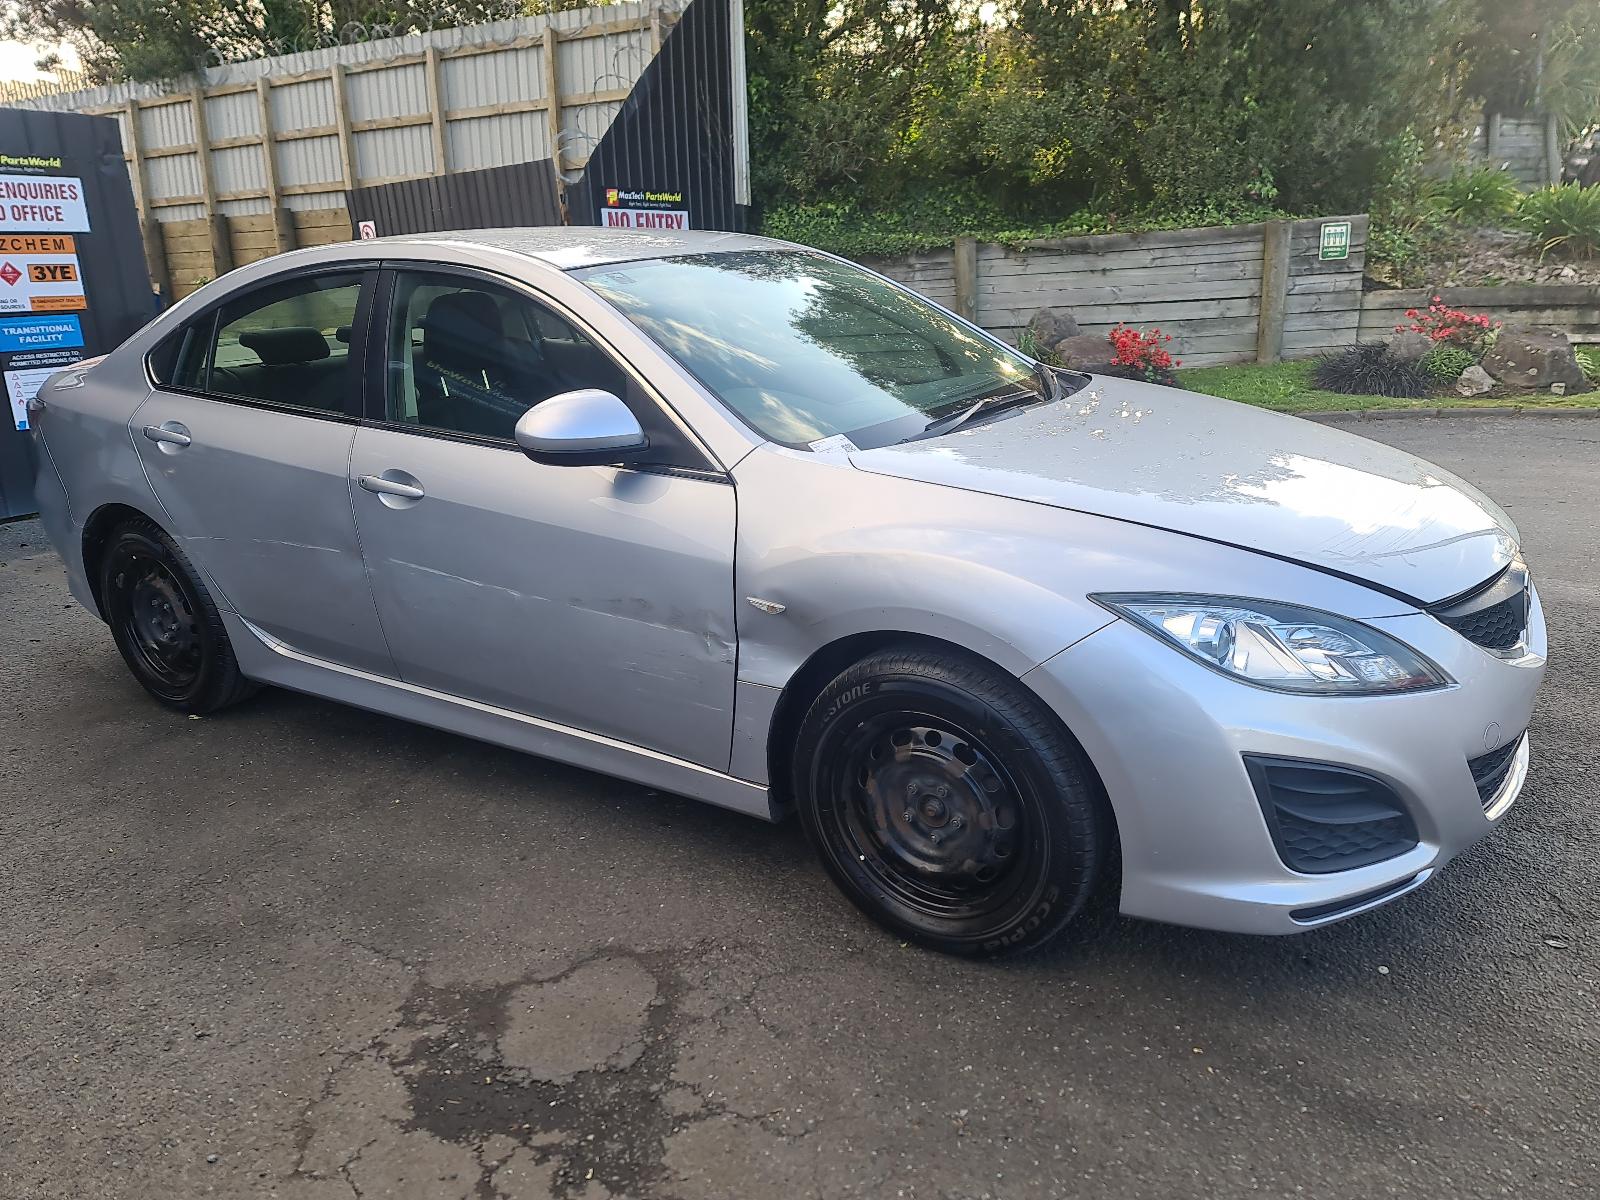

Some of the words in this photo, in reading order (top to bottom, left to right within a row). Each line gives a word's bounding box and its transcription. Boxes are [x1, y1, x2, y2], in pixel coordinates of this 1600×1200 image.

[0, 155, 61, 168] PartsWorld
[0, 182, 78, 201] ENQUIRIES
[645, 191, 682, 202] PartsWorld
[11, 204, 64, 221] OFFICE
[607, 211, 631, 227] NO
[635, 212, 683, 229] ENTRY
[33, 265, 73, 280] 3YE
[2, 324, 75, 335] TRANSITIONAL
[19, 334, 63, 344] FACILITY
[9, 359, 41, 367] PERMITTED
[42, 357, 68, 365] PERSONS
[12, 353, 35, 361] ACCESS
[36, 351, 70, 359] RESTRICTED
